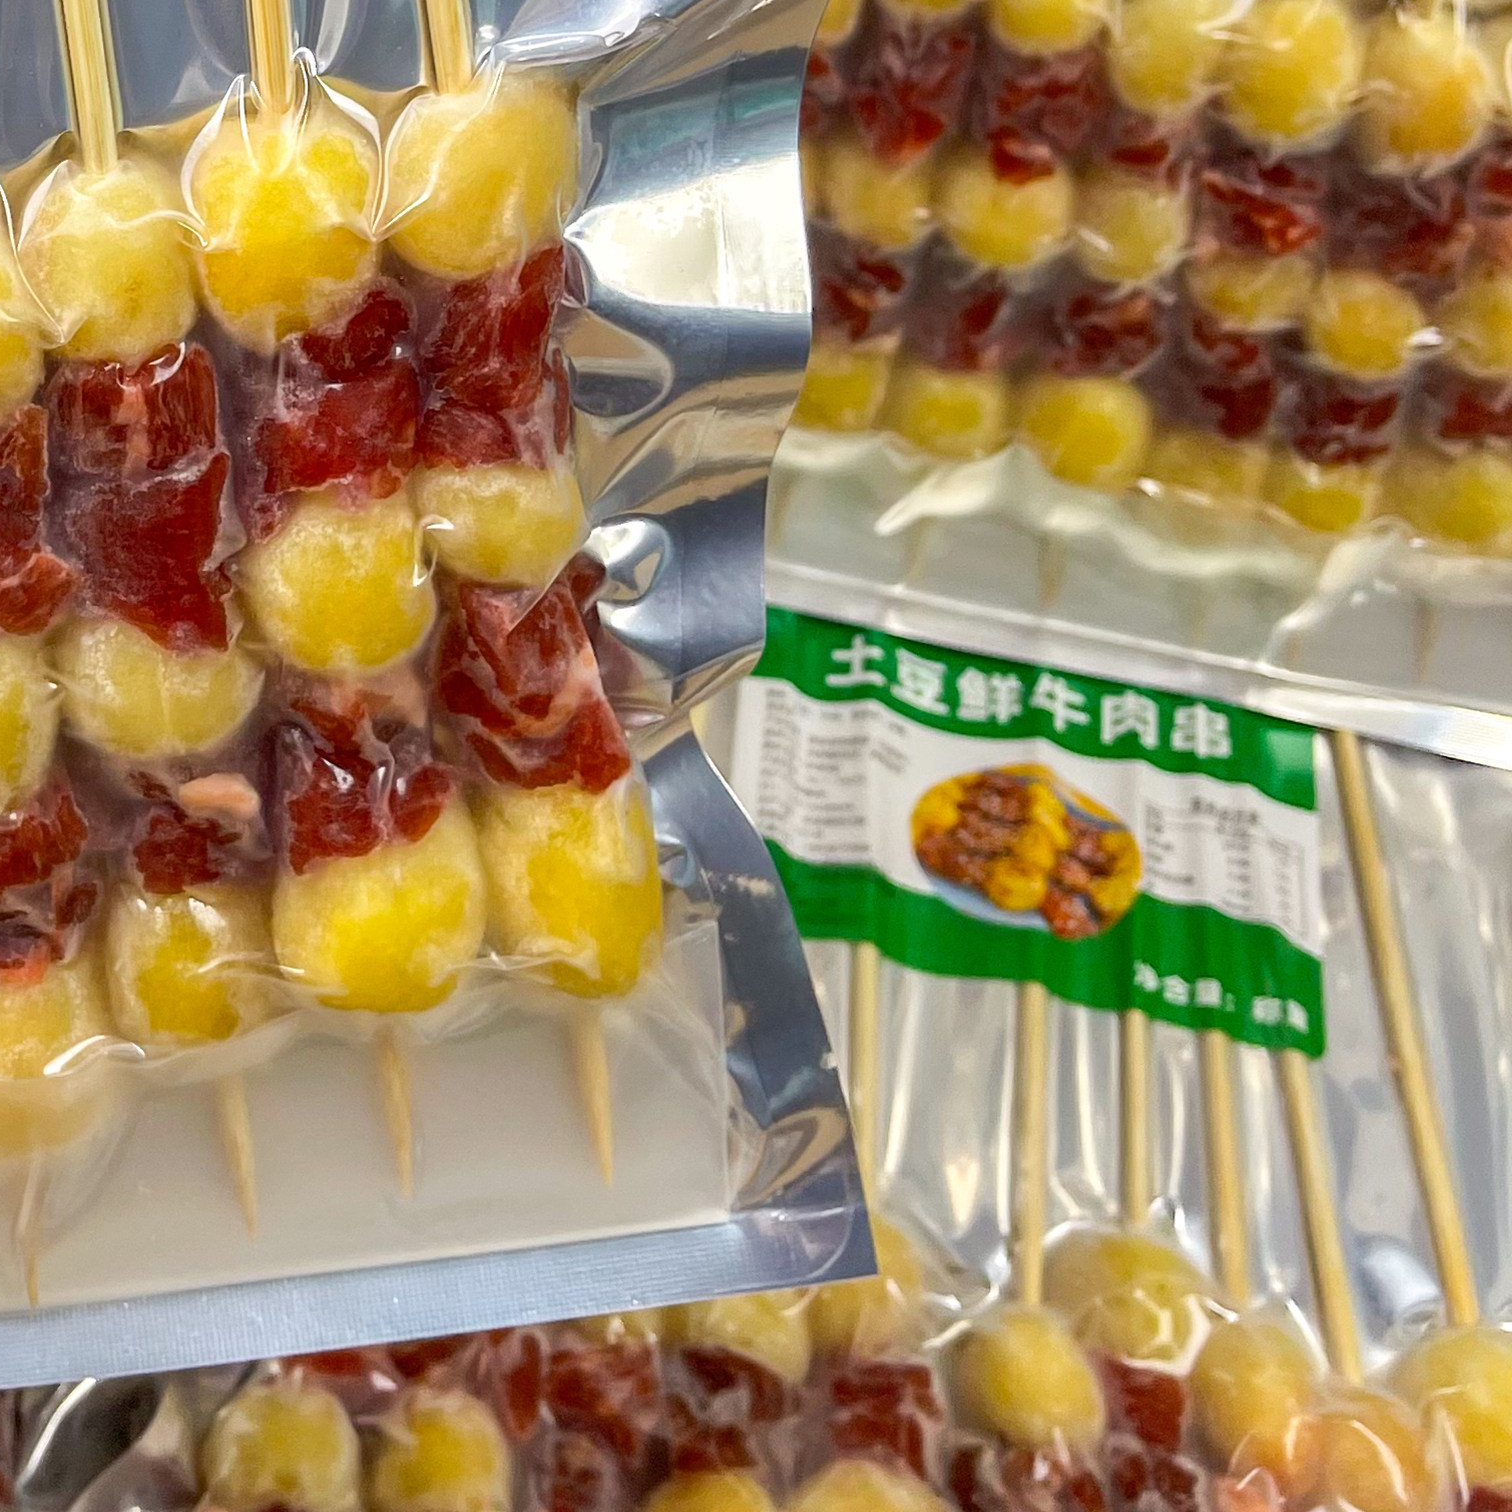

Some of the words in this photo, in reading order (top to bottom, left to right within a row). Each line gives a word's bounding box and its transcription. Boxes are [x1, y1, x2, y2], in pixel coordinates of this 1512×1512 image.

[825, 634, 1233, 760] 土豆鲜牛肉串
